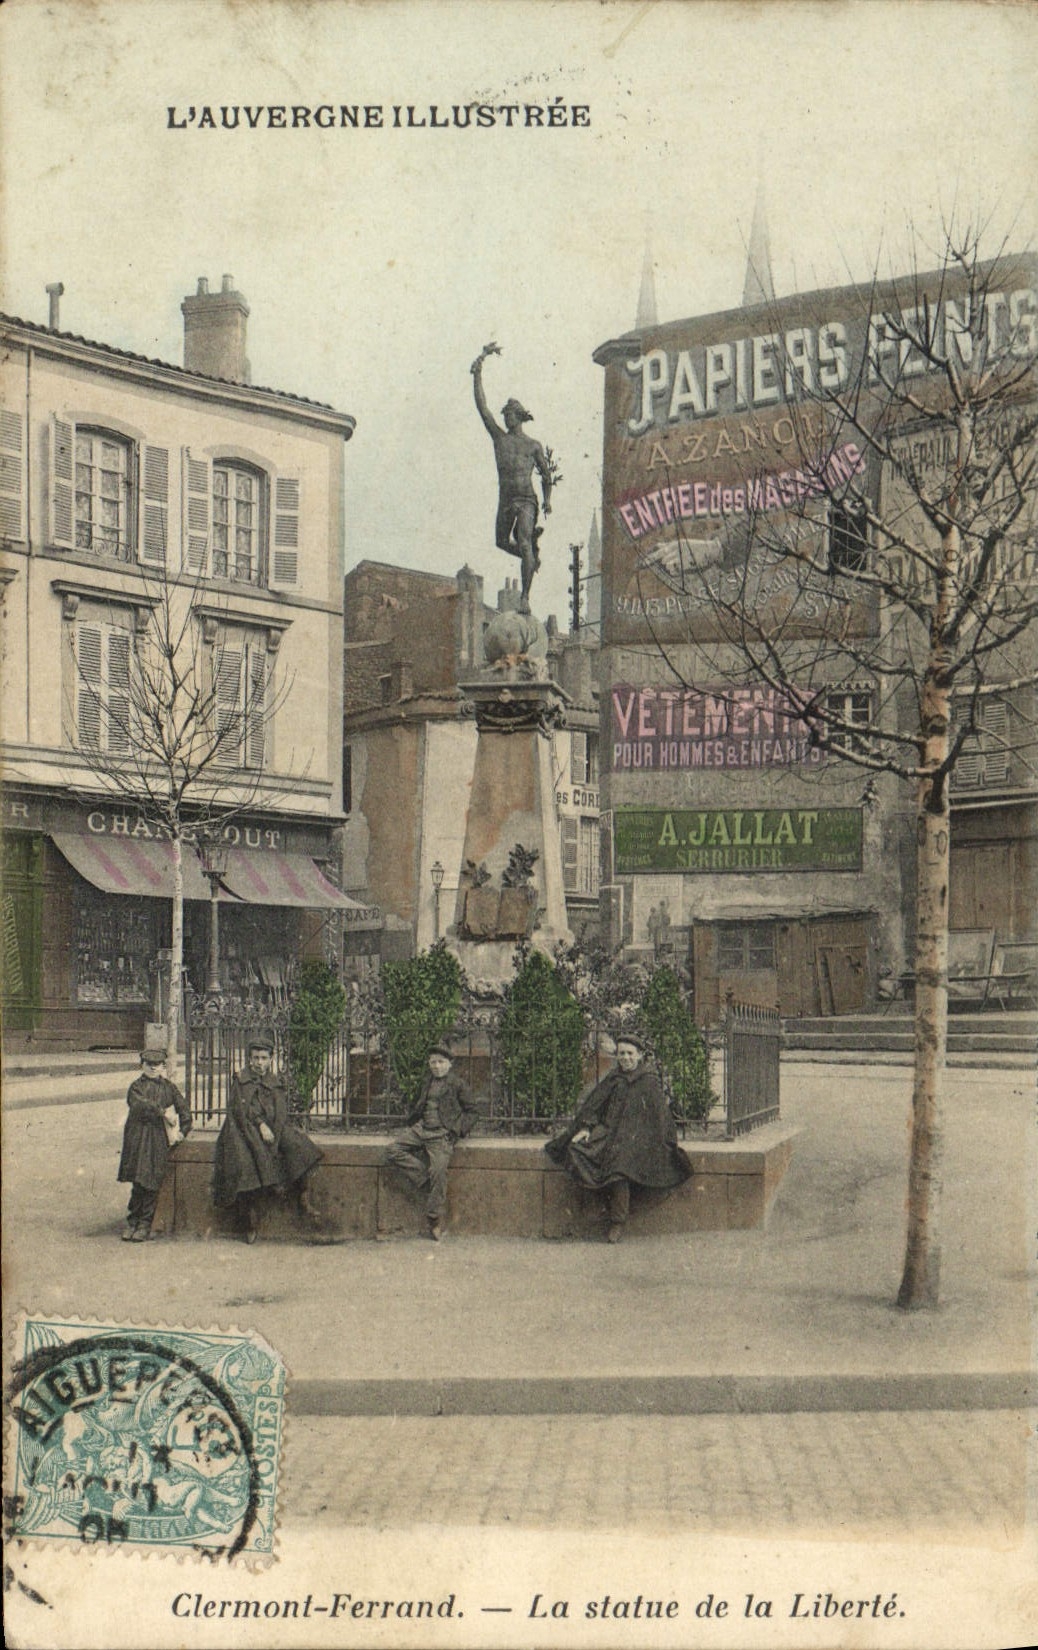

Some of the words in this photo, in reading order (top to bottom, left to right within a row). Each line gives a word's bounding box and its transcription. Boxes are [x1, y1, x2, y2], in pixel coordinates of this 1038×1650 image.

[627, 321, 849, 435] PAPIERS
[619, 480, 708, 538] ENTRÉE
[710, 481, 744, 514] des
[613, 742, 653, 768] POUR
[676, 847, 783, 869] SERRURIER
